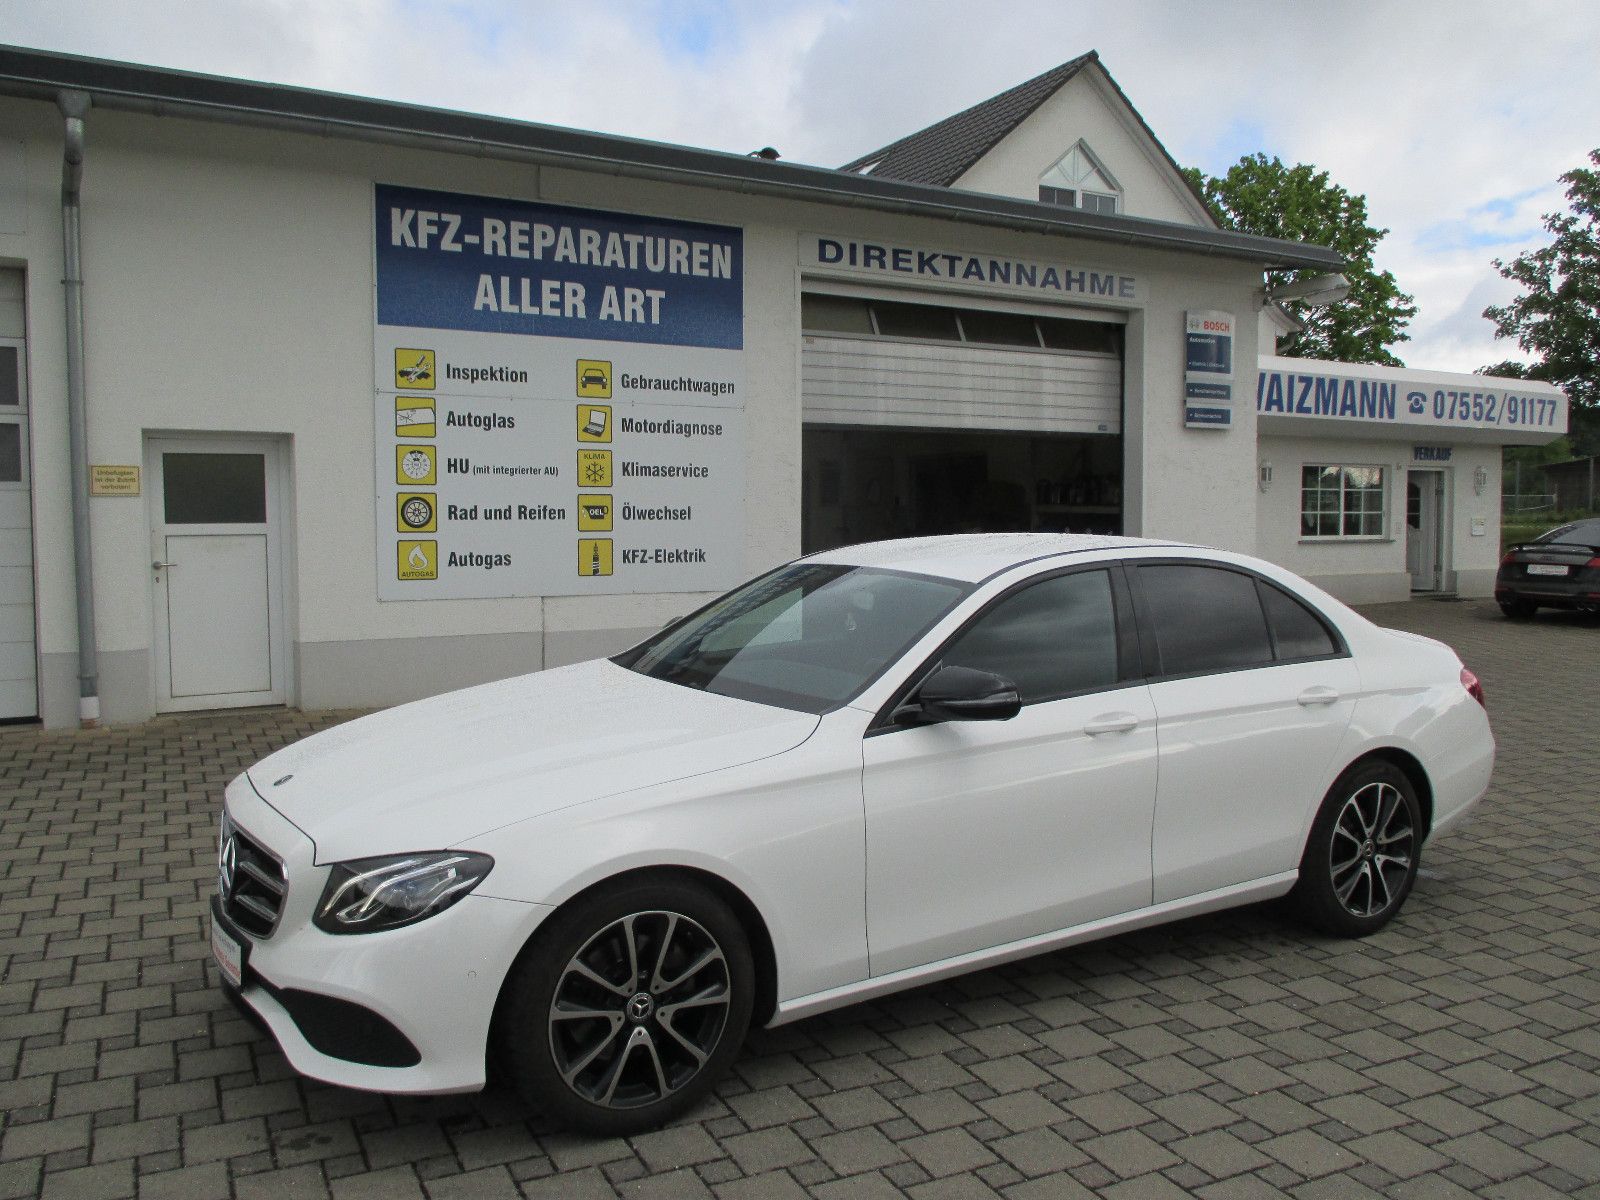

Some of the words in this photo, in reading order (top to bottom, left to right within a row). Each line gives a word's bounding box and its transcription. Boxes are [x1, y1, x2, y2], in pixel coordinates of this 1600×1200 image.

[391, 207, 732, 280] KFZ-REPARATUREN
[818, 239, 1136, 298] DIREKTANNAHME
[473, 273, 587, 319] ALLER
[599, 285, 666, 325] ART
[1203, 320, 1230, 332] BOSCH
[446, 363, 529, 384] Inspektion
[621, 373, 735, 396] Gebrauchtwagen
[1432, 389, 1557, 426] 07552/91177
[446, 410, 516, 432] Autoglas
[621, 417, 723, 438] Motordiagnose
[583, 452, 606, 460] KLIMA
[1413, 446, 1452, 461] VERKAUF
[447, 457, 470, 474] HU
[472, 464, 490, 475] (mit
[492, 465, 542, 477] integrierter
[544, 467, 559, 477] AU)
[621, 461, 709, 478] Klimaservice
[447, 504, 478, 521] Rad
[484, 504, 511, 521] und
[517, 504, 566, 521] Reifen
[589, 508, 604, 516] OEL
[622, 502, 691, 521] Ölwechsel
[447, 551, 512, 570] Autogas
[622, 548, 706, 564] KFZ-Elektrik
[401, 570, 434, 578] AUTOGAS
